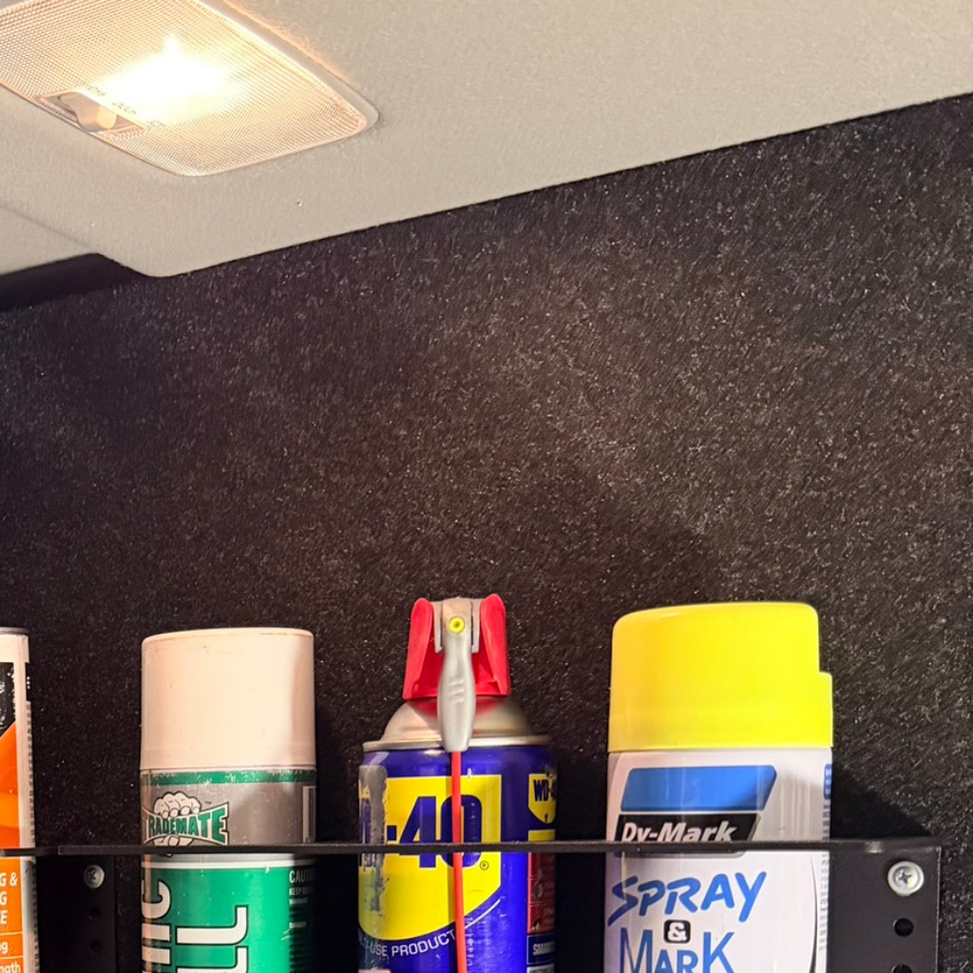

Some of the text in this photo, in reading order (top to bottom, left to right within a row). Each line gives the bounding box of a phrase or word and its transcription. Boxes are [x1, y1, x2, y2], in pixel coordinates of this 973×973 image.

[148, 806, 226, 843] RADEMATE
[621, 821, 737, 843] Dy-Mark
[9, 871, 18, 887] &
[608, 871, 767, 927] SPRAY
[390, 929, 456, 957] PRODUCT
[667, 922, 687, 942] &
